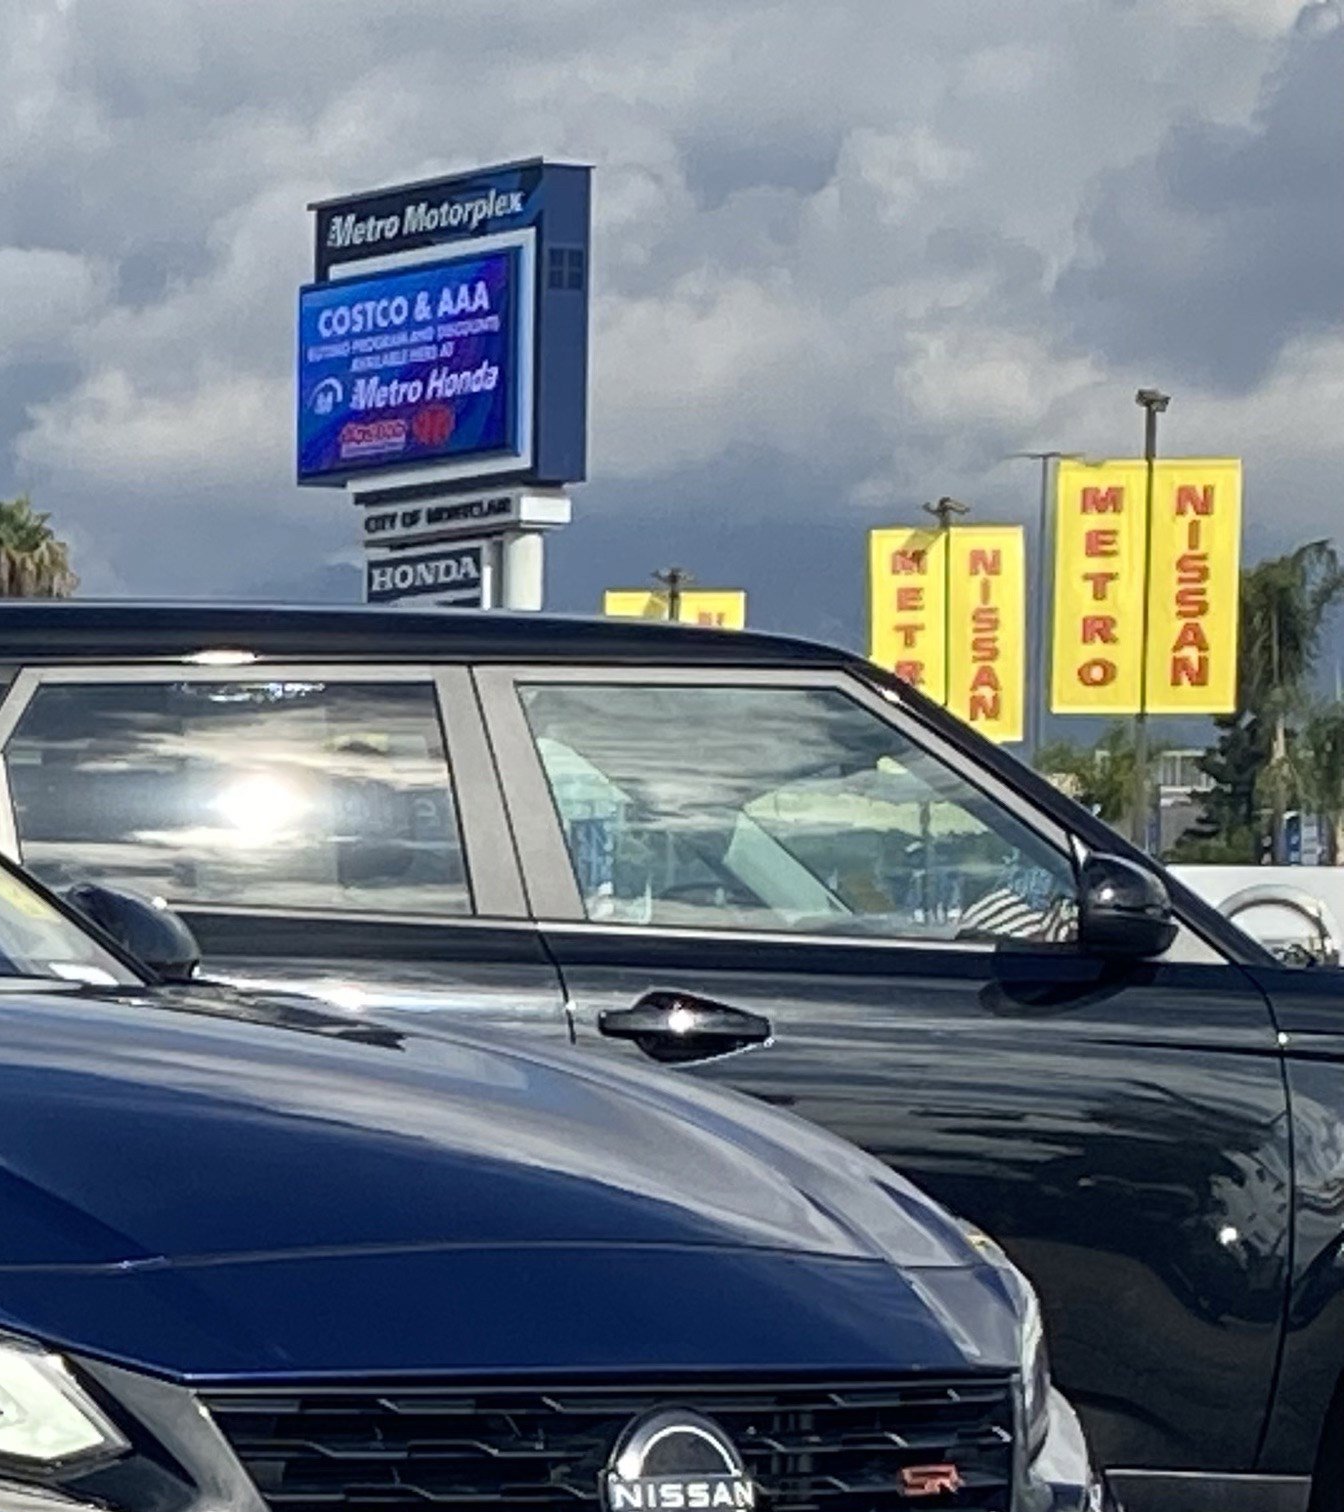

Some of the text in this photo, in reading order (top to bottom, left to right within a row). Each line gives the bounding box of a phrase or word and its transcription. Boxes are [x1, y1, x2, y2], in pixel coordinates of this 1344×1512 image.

[327, 188, 525, 248] Metro Motorplex
[318, 281, 491, 338] COSTCO & AAA
[349, 376, 423, 411] Metro
[425, 360, 500, 400] Honda
[372, 556, 480, 591] HONDA
[1077, 486, 1125, 687] METRO
[1170, 484, 1215, 687] NISSAN
[891, 549, 927, 688] METR
[969, 549, 1002, 722] NISSAN
[612, 1480, 756, 1509] NISSAN
